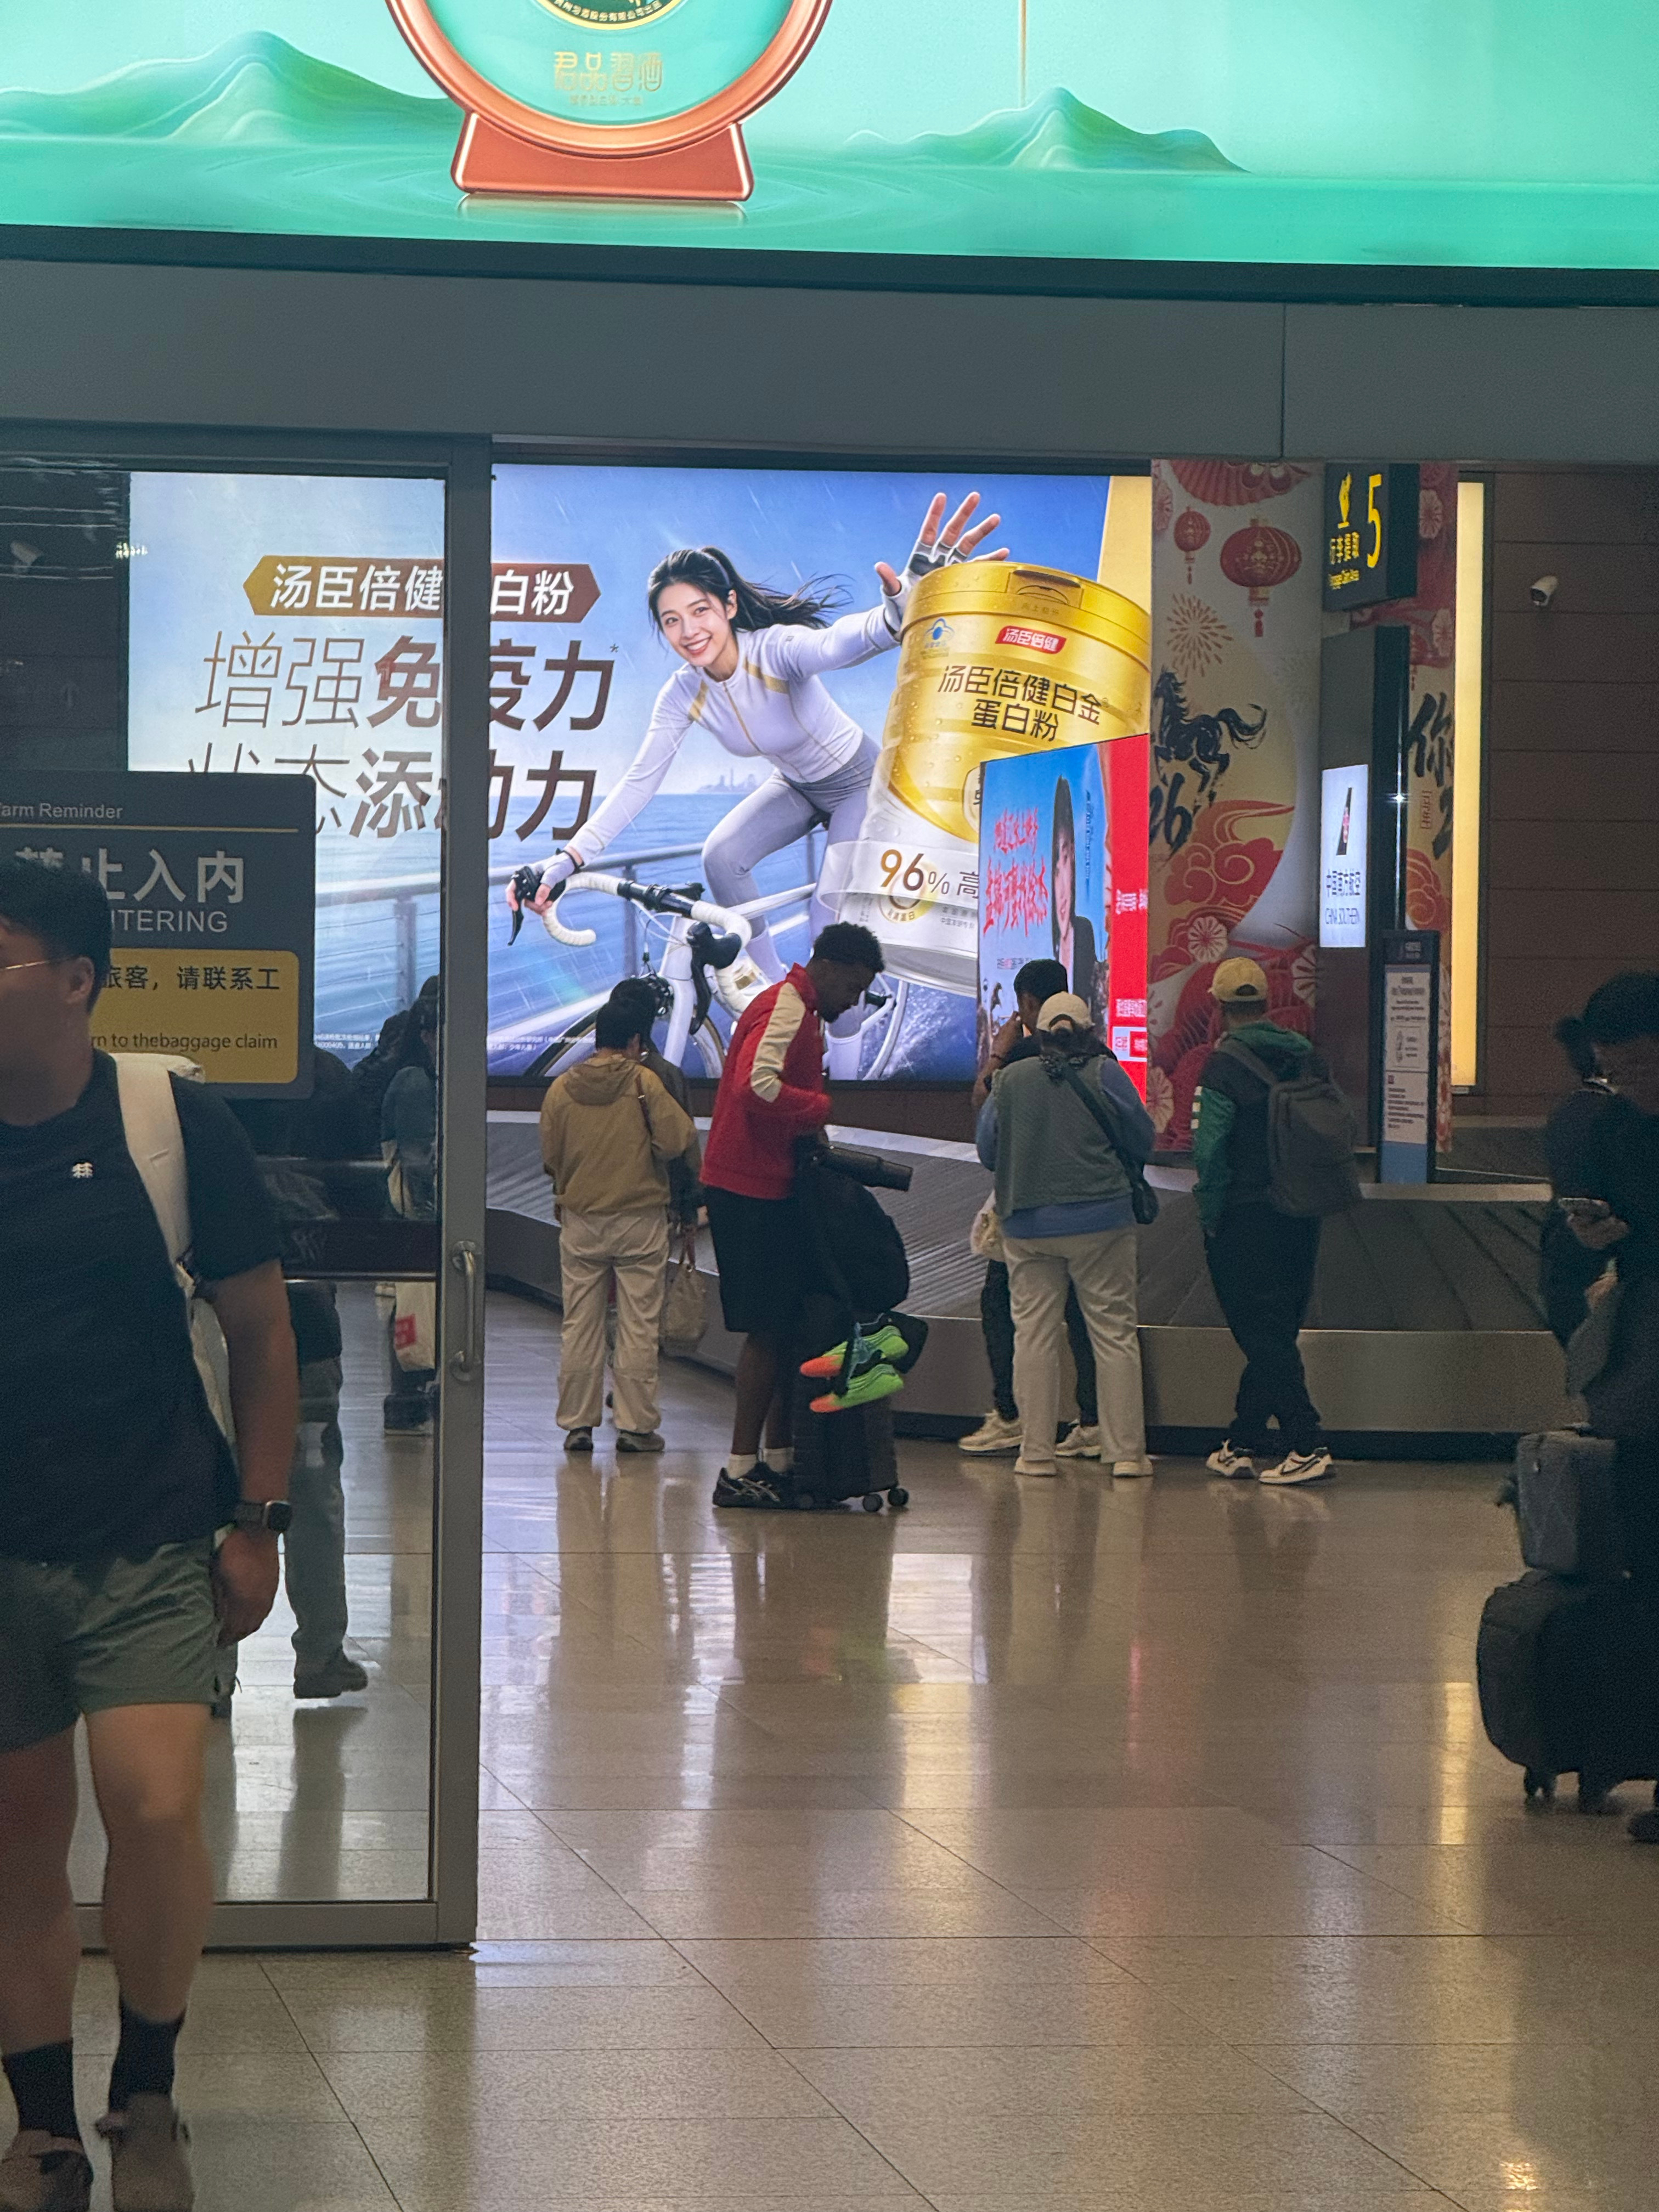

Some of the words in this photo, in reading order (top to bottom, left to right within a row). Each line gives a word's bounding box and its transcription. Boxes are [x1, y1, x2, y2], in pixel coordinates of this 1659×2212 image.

[1367, 474, 1382, 568] 5
[270, 563, 574, 616] 汤臣倍健白粉
[1002, 628, 1059, 652] 汤臣倍健
[938, 666, 1101, 725] 汤臣倍健白金
[971, 698, 1058, 742] 蛋白粉
[0, 803, 33, 817] arm
[40, 803, 123, 819] Reminder
[188, 742, 597, 842] 态添力
[881, 849, 950, 895] 96%
[111, 910, 228, 933] TERING
[111, 1034, 128, 1048] to
[235, 1033, 278, 1049] claim
